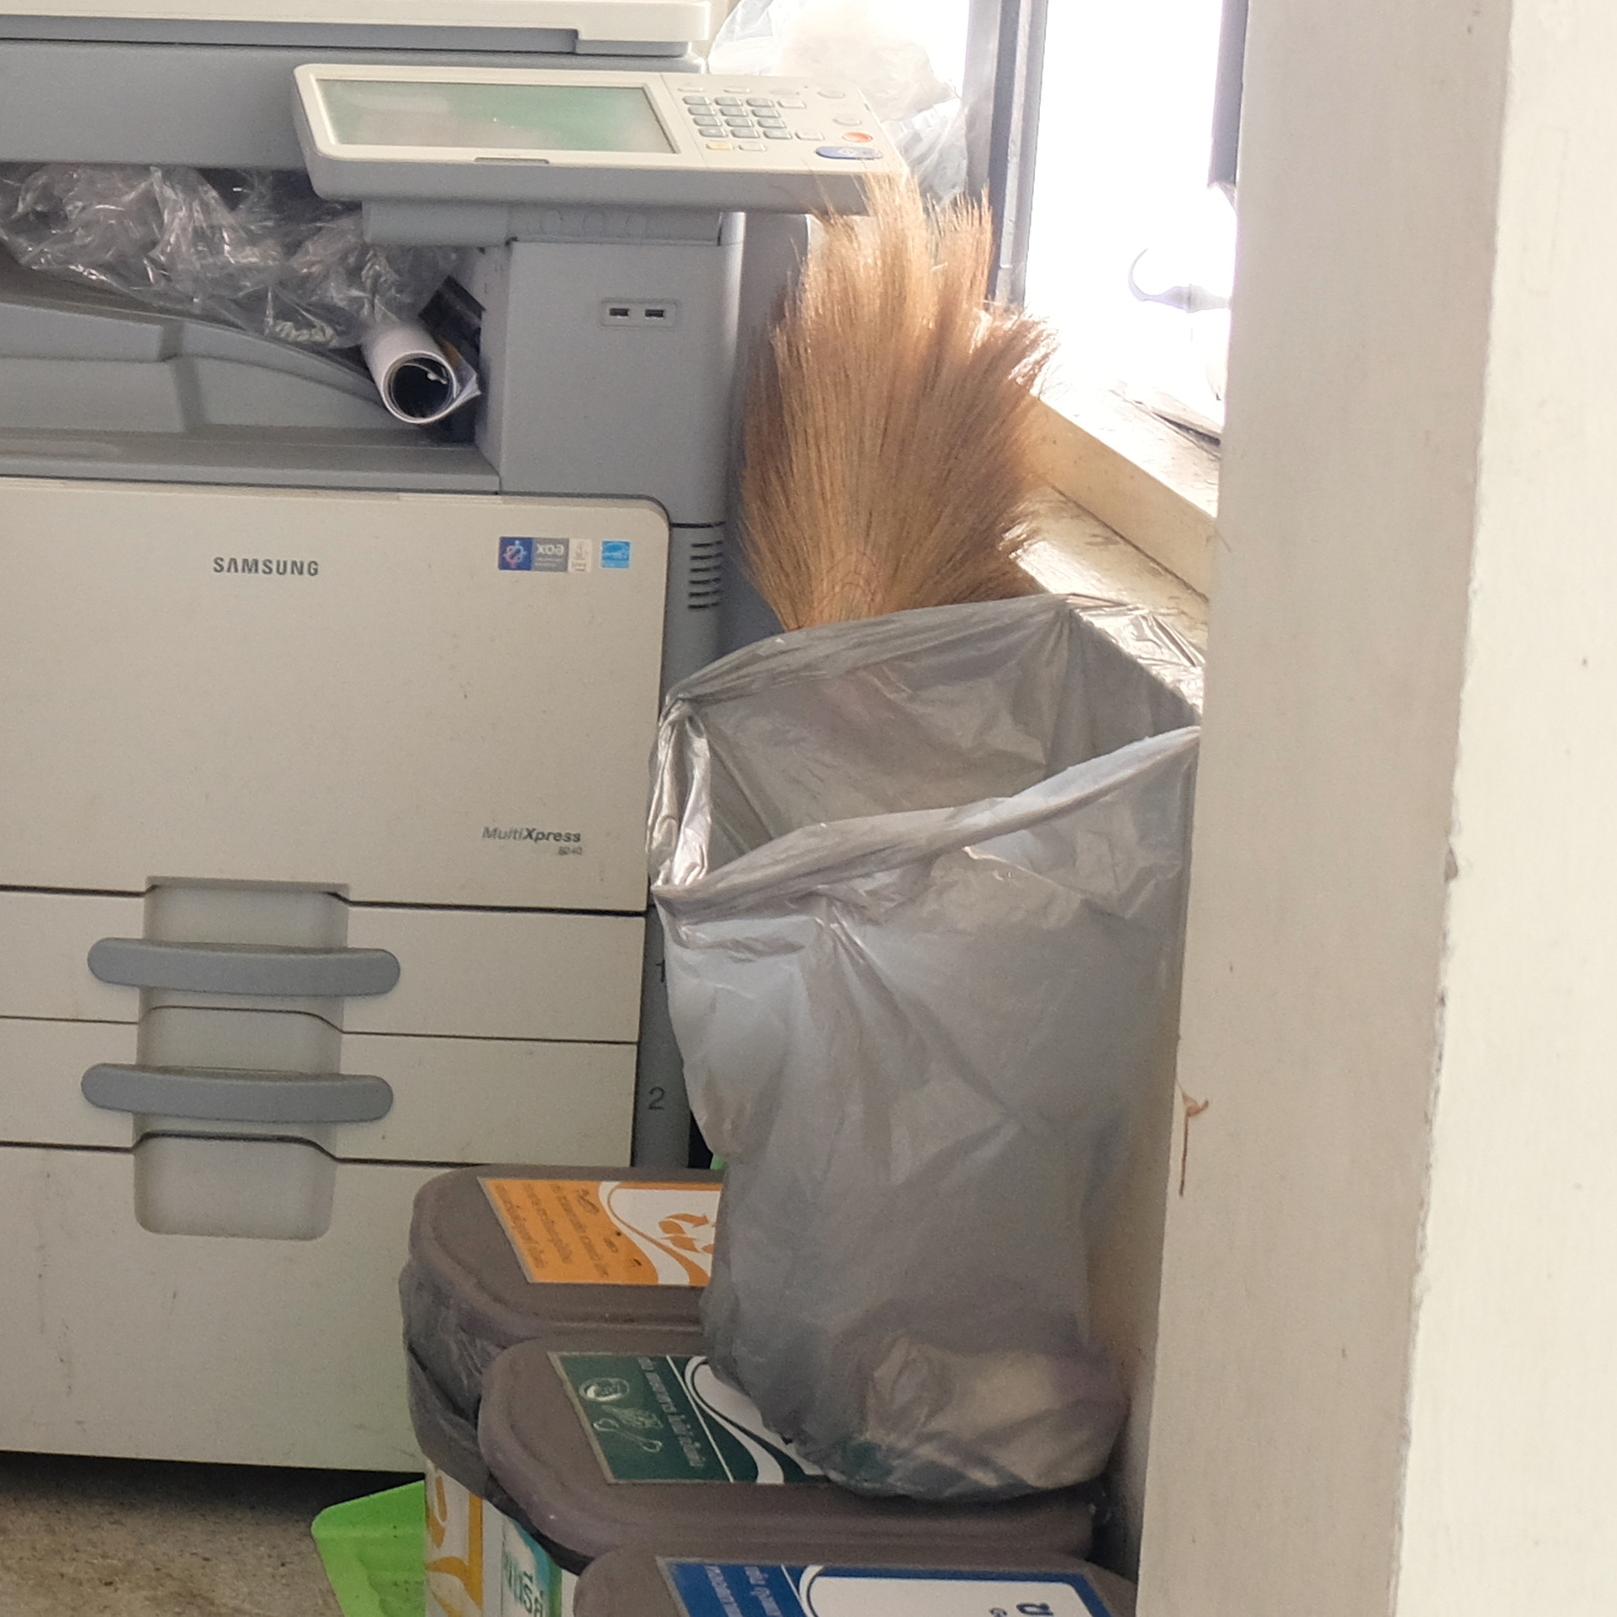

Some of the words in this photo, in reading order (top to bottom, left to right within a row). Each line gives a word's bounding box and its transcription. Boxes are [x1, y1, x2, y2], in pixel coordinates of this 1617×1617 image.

[212, 556, 319, 577] SAMSUNG
[482, 826, 581, 844] MultiXpress
[649, 1086, 664, 1110] 2
